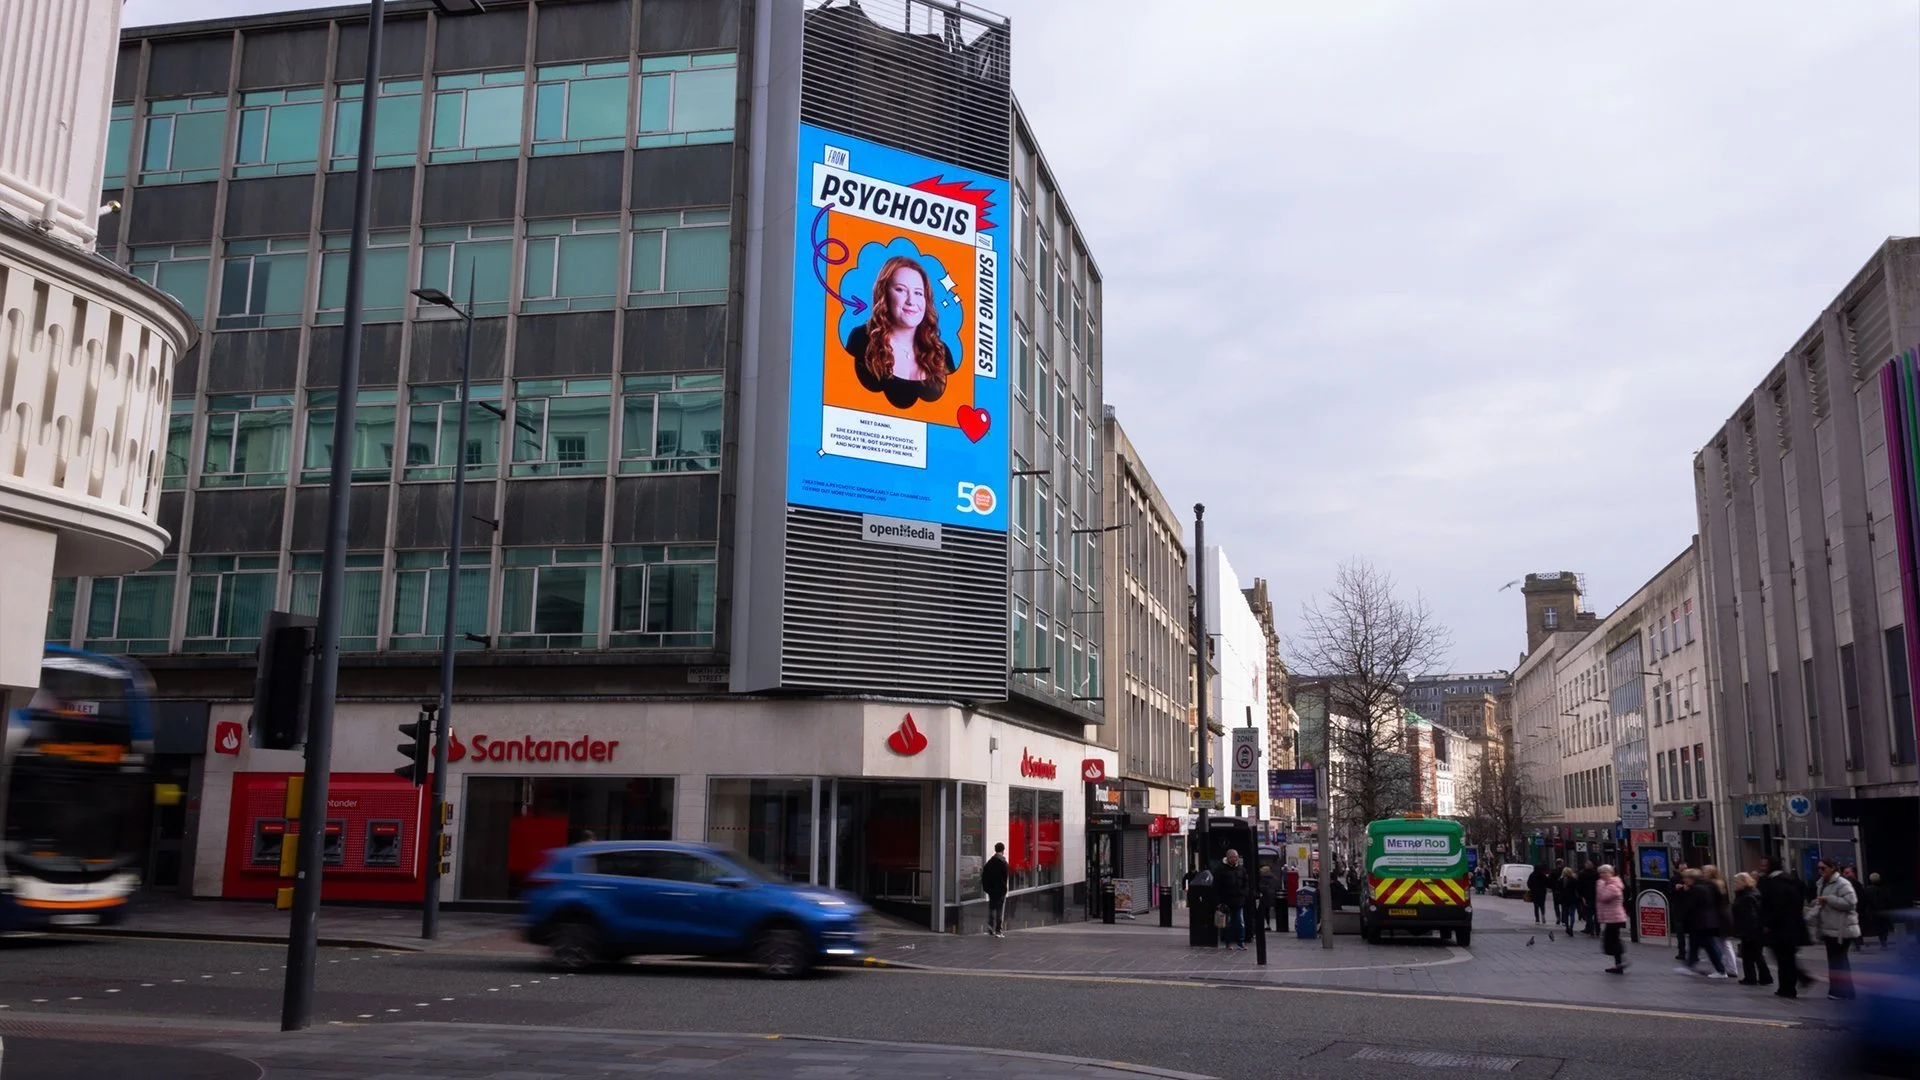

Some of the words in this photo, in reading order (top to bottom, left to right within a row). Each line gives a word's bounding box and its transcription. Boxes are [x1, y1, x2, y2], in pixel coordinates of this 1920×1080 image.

[828, 149, 846, 166] FROM
[820, 174, 969, 236] PSYCHOSIS
[979, 253, 994, 320] SAVING
[979, 322, 993, 374] LIVES
[830, 433, 852, 442] EPISODE
[879, 441, 902, 450] SUPPORT
[846, 428, 881, 440] EXPERIENCED
[885, 435, 914, 445] PSYCHOTIC
[862, 445, 881, 453] WORKS
[956, 481, 997, 516] 50
[78, 704, 94, 713] LET
[1237, 735, 1255, 743] ZONE
[471, 734, 620, 764] Santander
[327, 798, 358, 809] ntander
[1425, 839, 1446, 848] ROD
